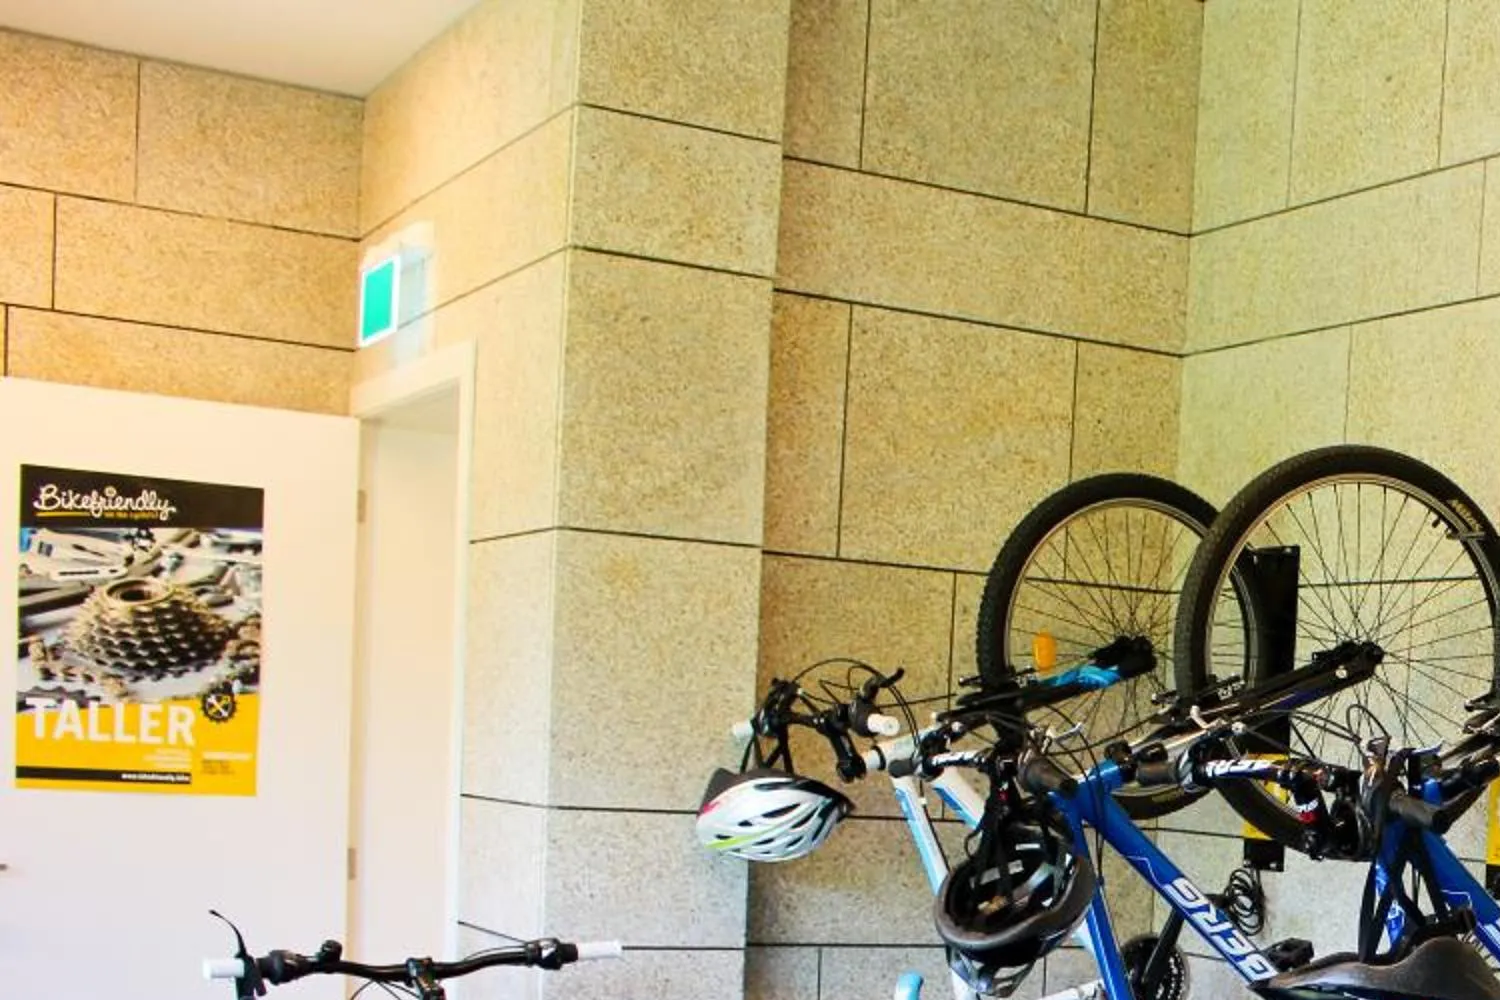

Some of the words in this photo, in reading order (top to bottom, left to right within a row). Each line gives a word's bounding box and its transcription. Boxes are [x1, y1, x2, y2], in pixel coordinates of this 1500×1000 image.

[33, 484, 176, 520] Bikefriendly
[25, 697, 196, 746] TALLER
[1161, 876, 1279, 982] BERG
